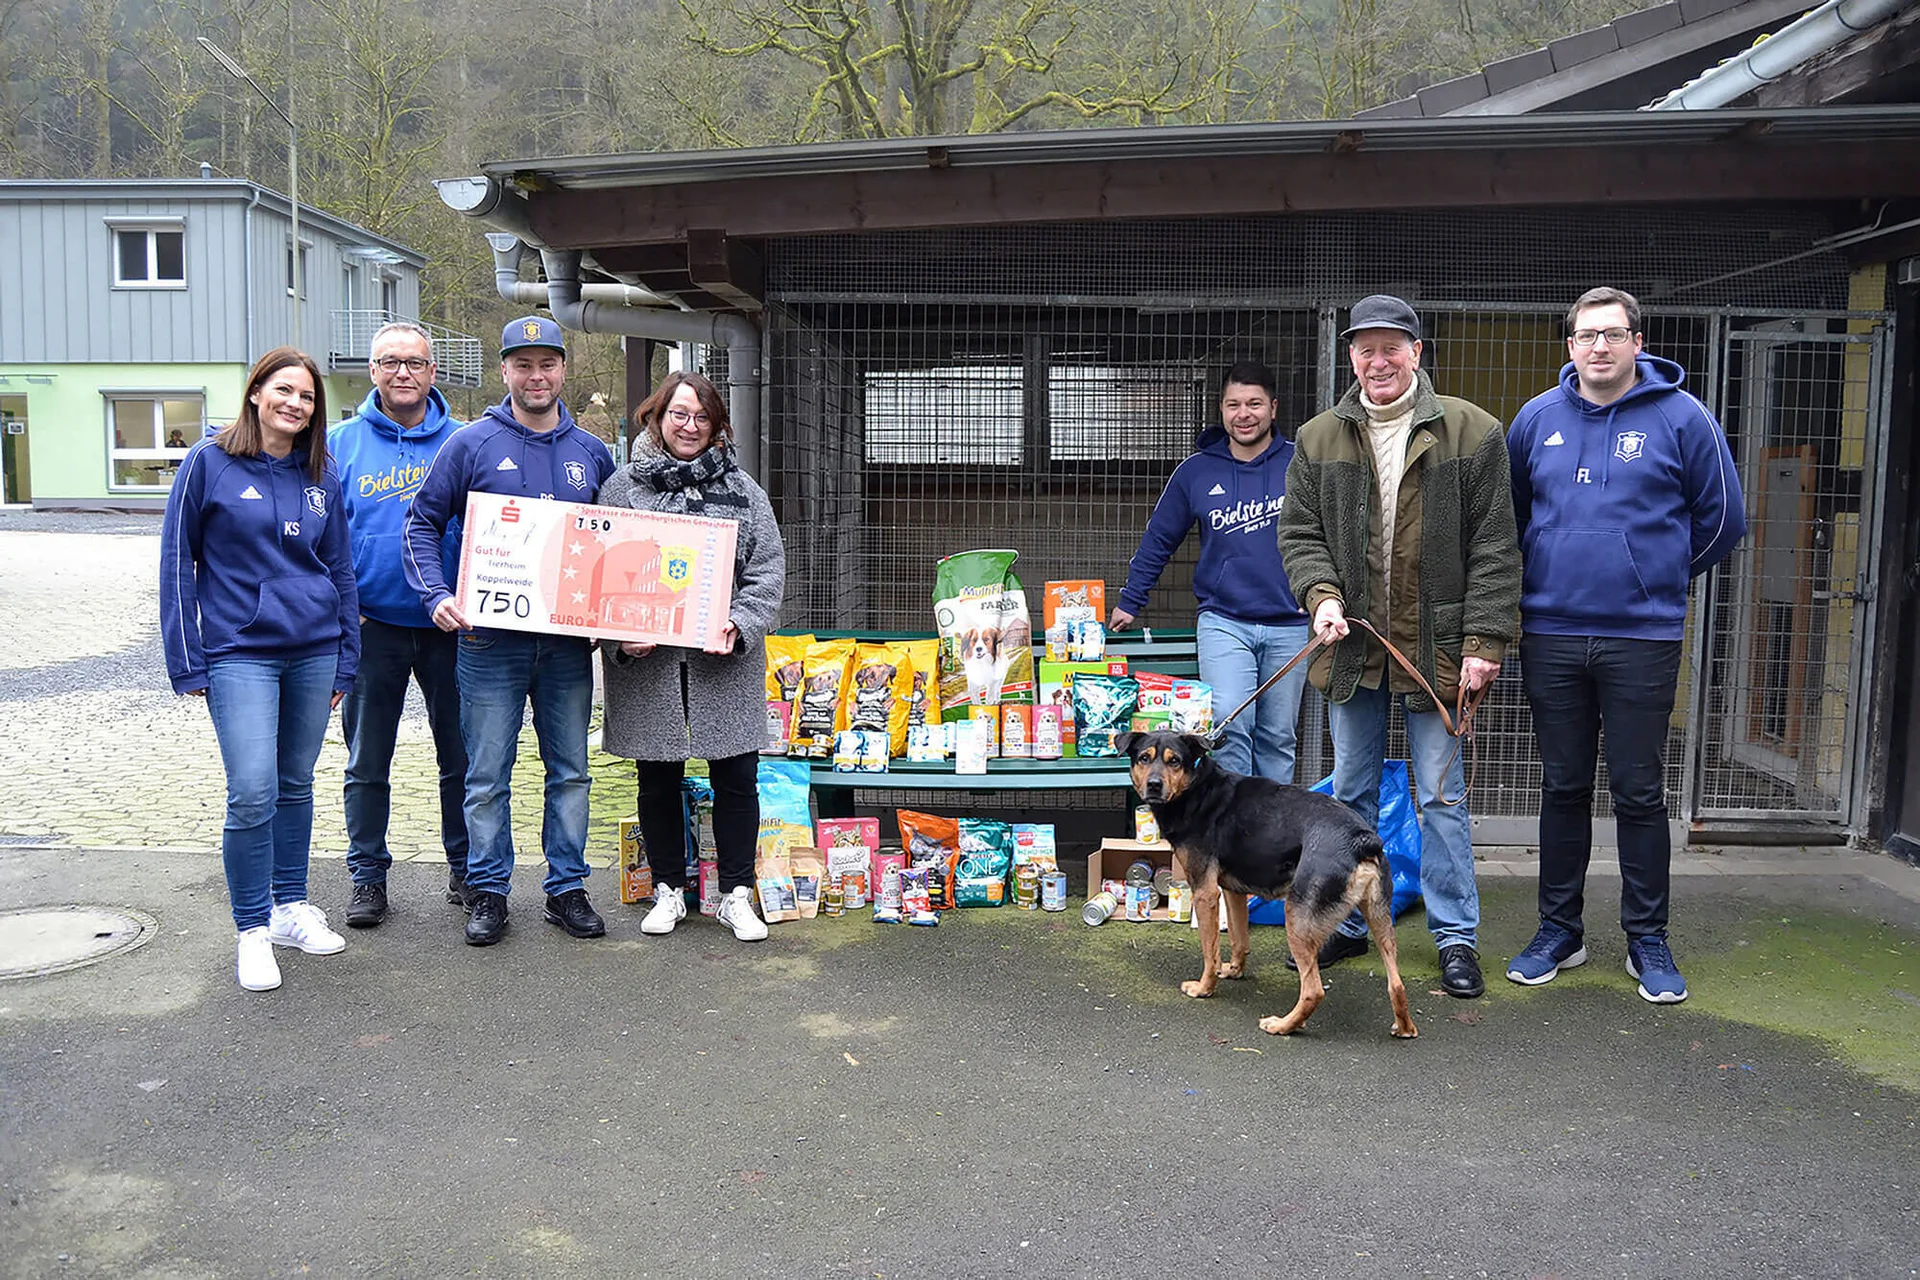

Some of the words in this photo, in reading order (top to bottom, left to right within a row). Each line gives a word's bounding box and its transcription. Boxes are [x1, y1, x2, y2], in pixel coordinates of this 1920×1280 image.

[357, 459, 428, 497] Bielstei
[1576, 468, 1592, 483] FL
[581, 505, 619, 516] Sparkasse
[284, 521, 300, 536] KS
[475, 545, 493, 556] Gut
[488, 559, 526, 570] Tierheim
[476, 573, 533, 587] Koppelweide
[477, 589, 530, 618] 750
[549, 613, 585, 627] EURO
[959, 858, 998, 876] ONE
